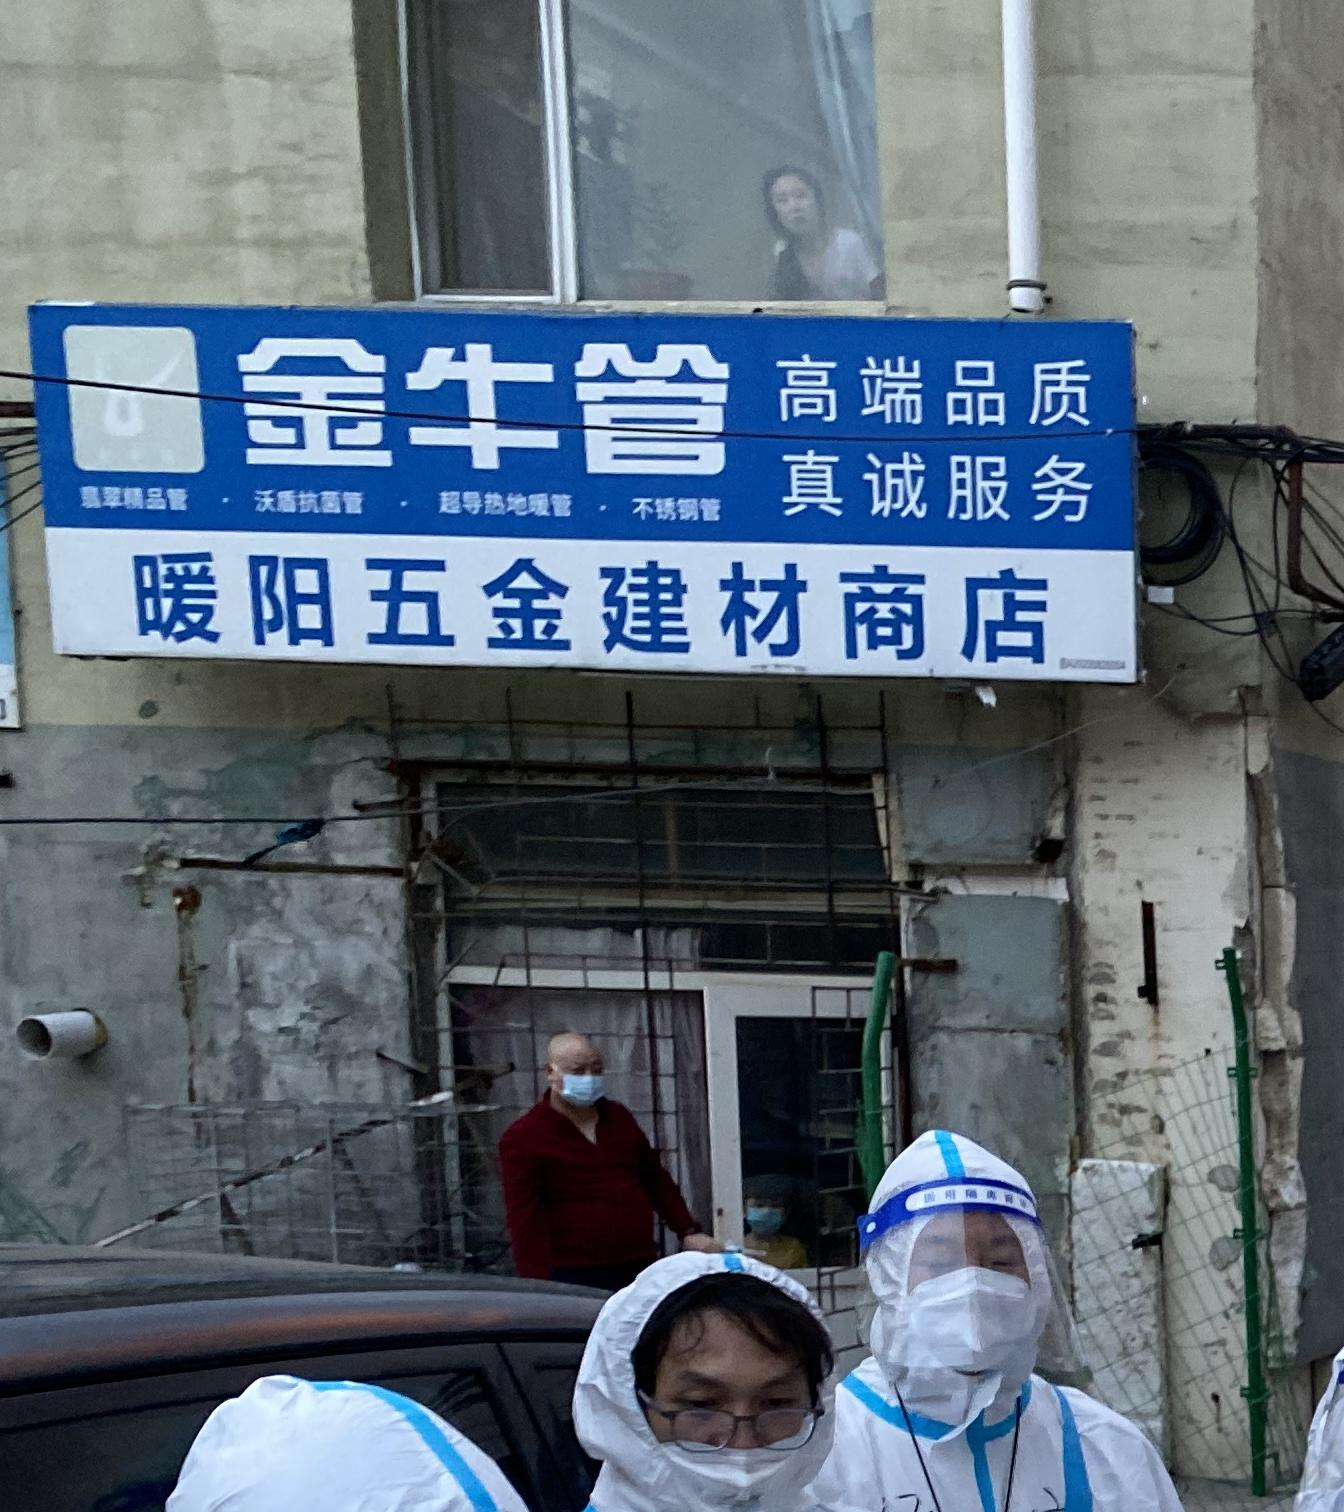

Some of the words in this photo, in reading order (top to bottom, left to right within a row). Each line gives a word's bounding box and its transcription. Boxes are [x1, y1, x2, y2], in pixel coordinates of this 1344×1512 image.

[237, 338, 730, 475] 金牛管
[775, 354, 1093, 427] 高端品质
[782, 449, 1094, 523] 真诚服务
[133, 552, 1048, 664] 暖阳五金建材商店
